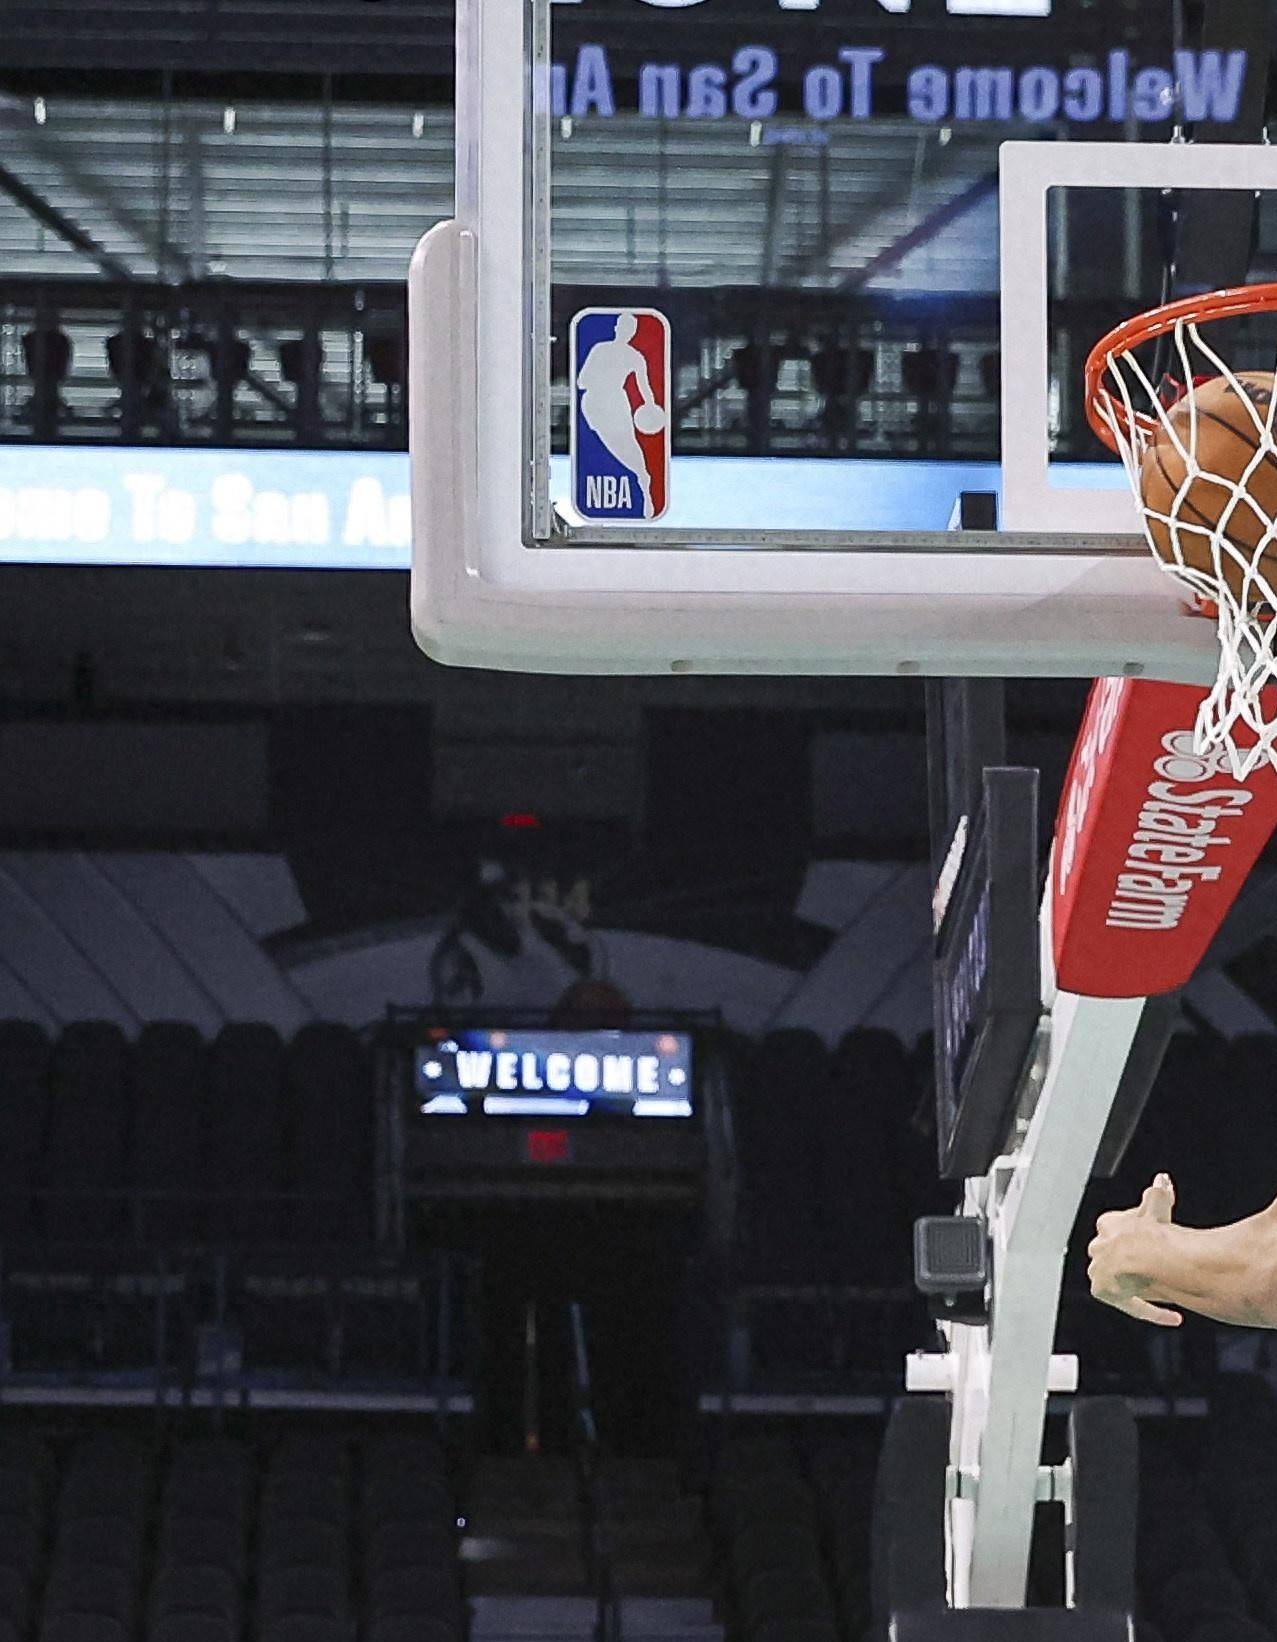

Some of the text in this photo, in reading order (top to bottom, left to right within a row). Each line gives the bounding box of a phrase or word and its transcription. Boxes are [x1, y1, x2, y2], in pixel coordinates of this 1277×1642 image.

[121, 472, 197, 543] To
[586, 475, 632, 509] NBA
[456, 1050, 660, 1094] WELCOME
